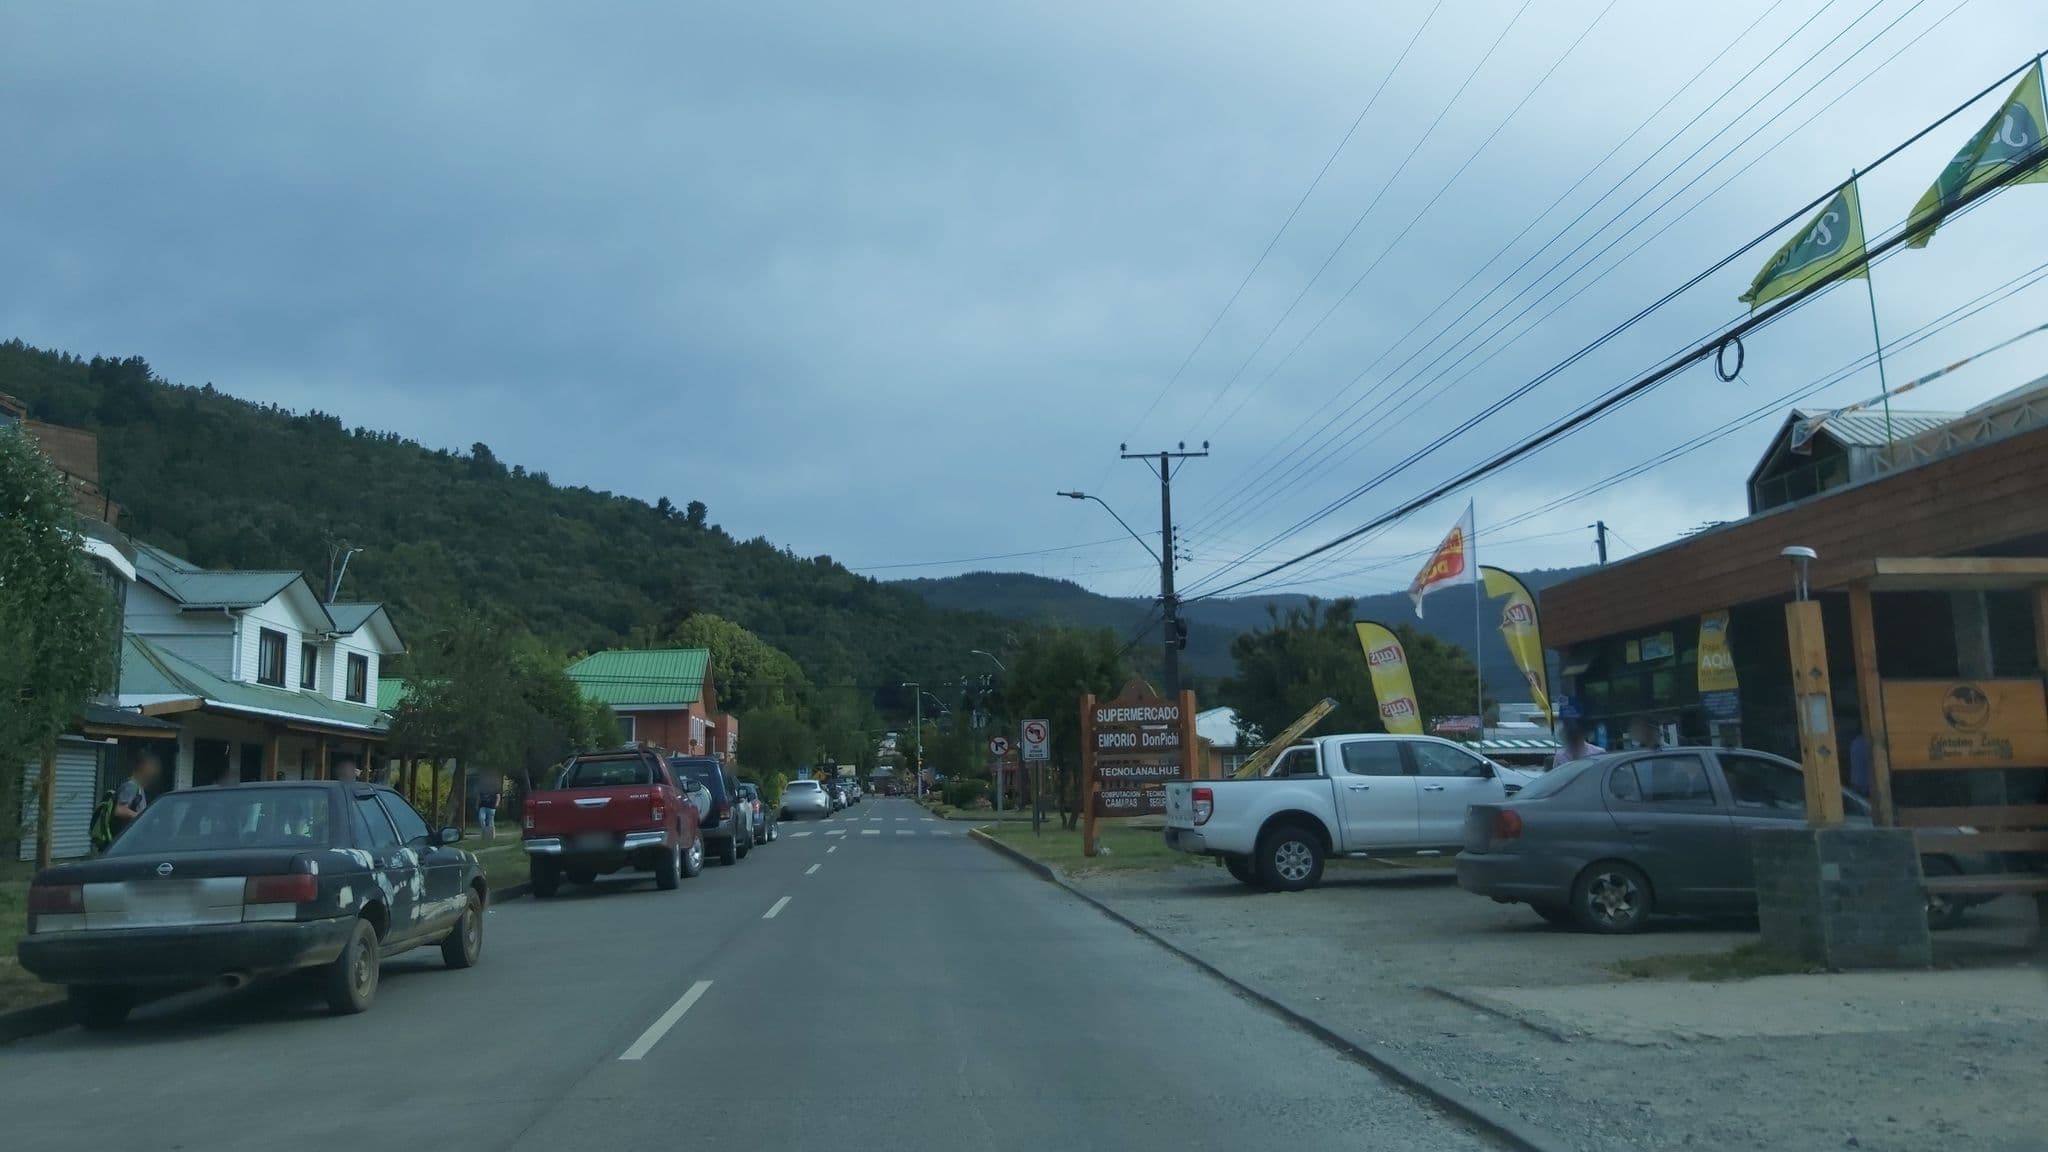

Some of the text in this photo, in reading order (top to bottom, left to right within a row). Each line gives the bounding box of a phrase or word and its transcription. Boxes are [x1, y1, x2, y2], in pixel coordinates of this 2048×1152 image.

[1097, 706, 1179, 722] SUPERMERCADO
[1098, 732, 1179, 747] EMPORIO DonPichi
[1100, 766, 1180, 776] TECNOLANALHUE
